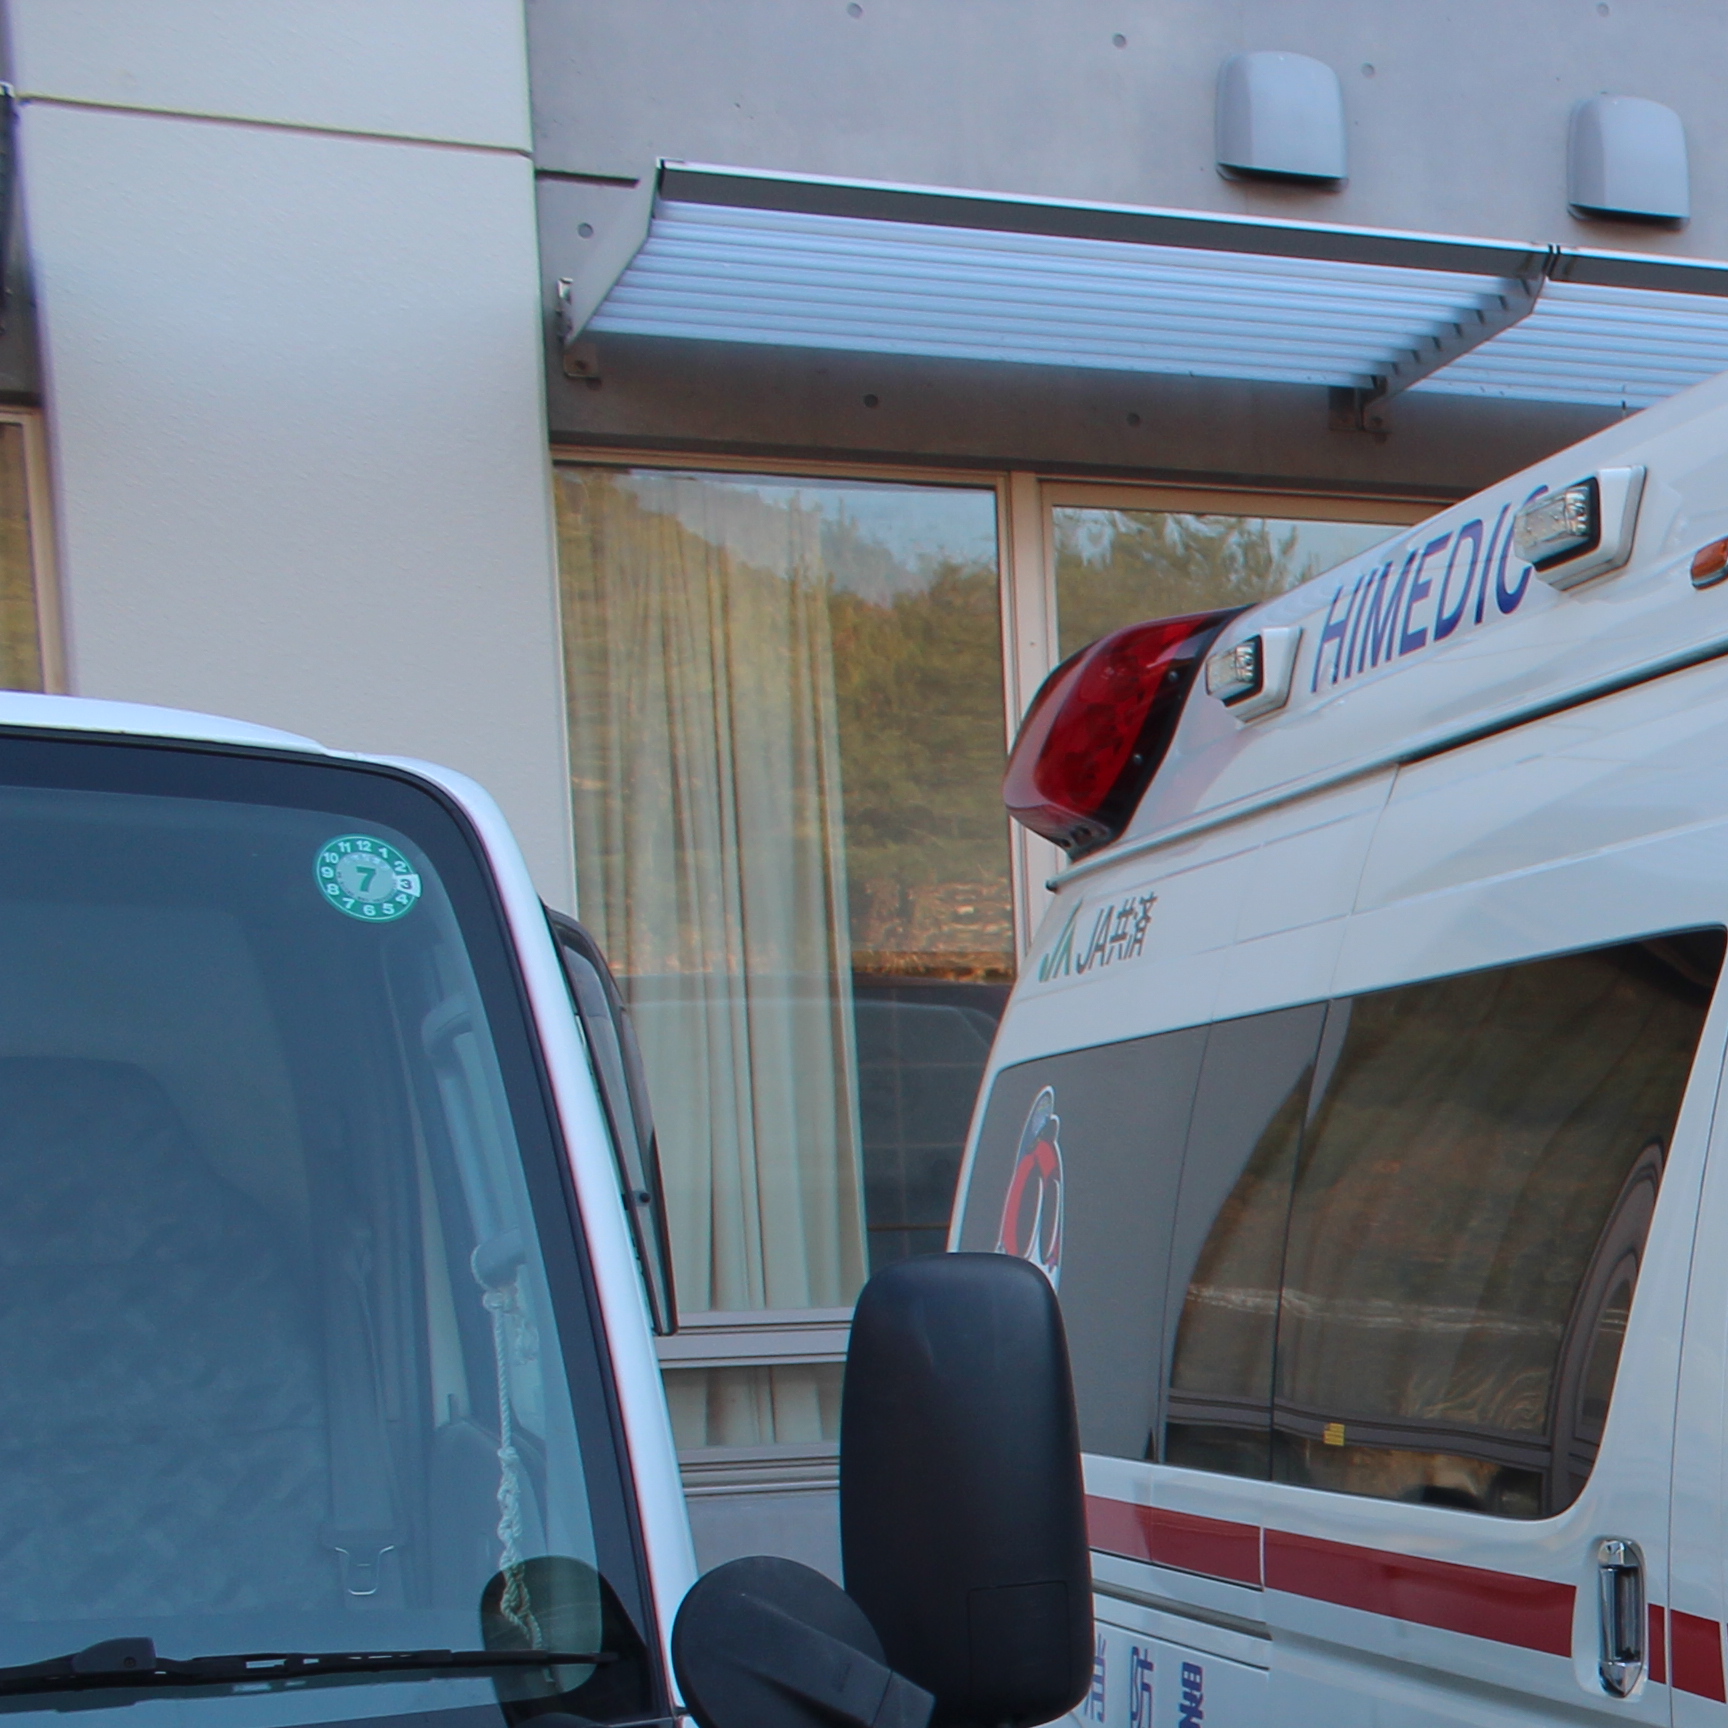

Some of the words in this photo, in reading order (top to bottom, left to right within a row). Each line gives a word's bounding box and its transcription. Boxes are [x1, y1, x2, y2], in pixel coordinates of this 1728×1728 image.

[1311, 484, 1548, 693] HIMEDIC
[356, 840, 372, 852] 12
[323, 852, 339, 864] 10
[321, 866, 334, 879] 9
[394, 861, 407, 873] 2
[356, 865, 376, 892] 7
[400, 879, 413, 890] 3
[327, 883, 340, 896] 8
[342, 897, 355, 909] 7
[395, 893, 408, 905] 4
[363, 904, 376, 917] 6
[382, 903, 395, 915] 5
